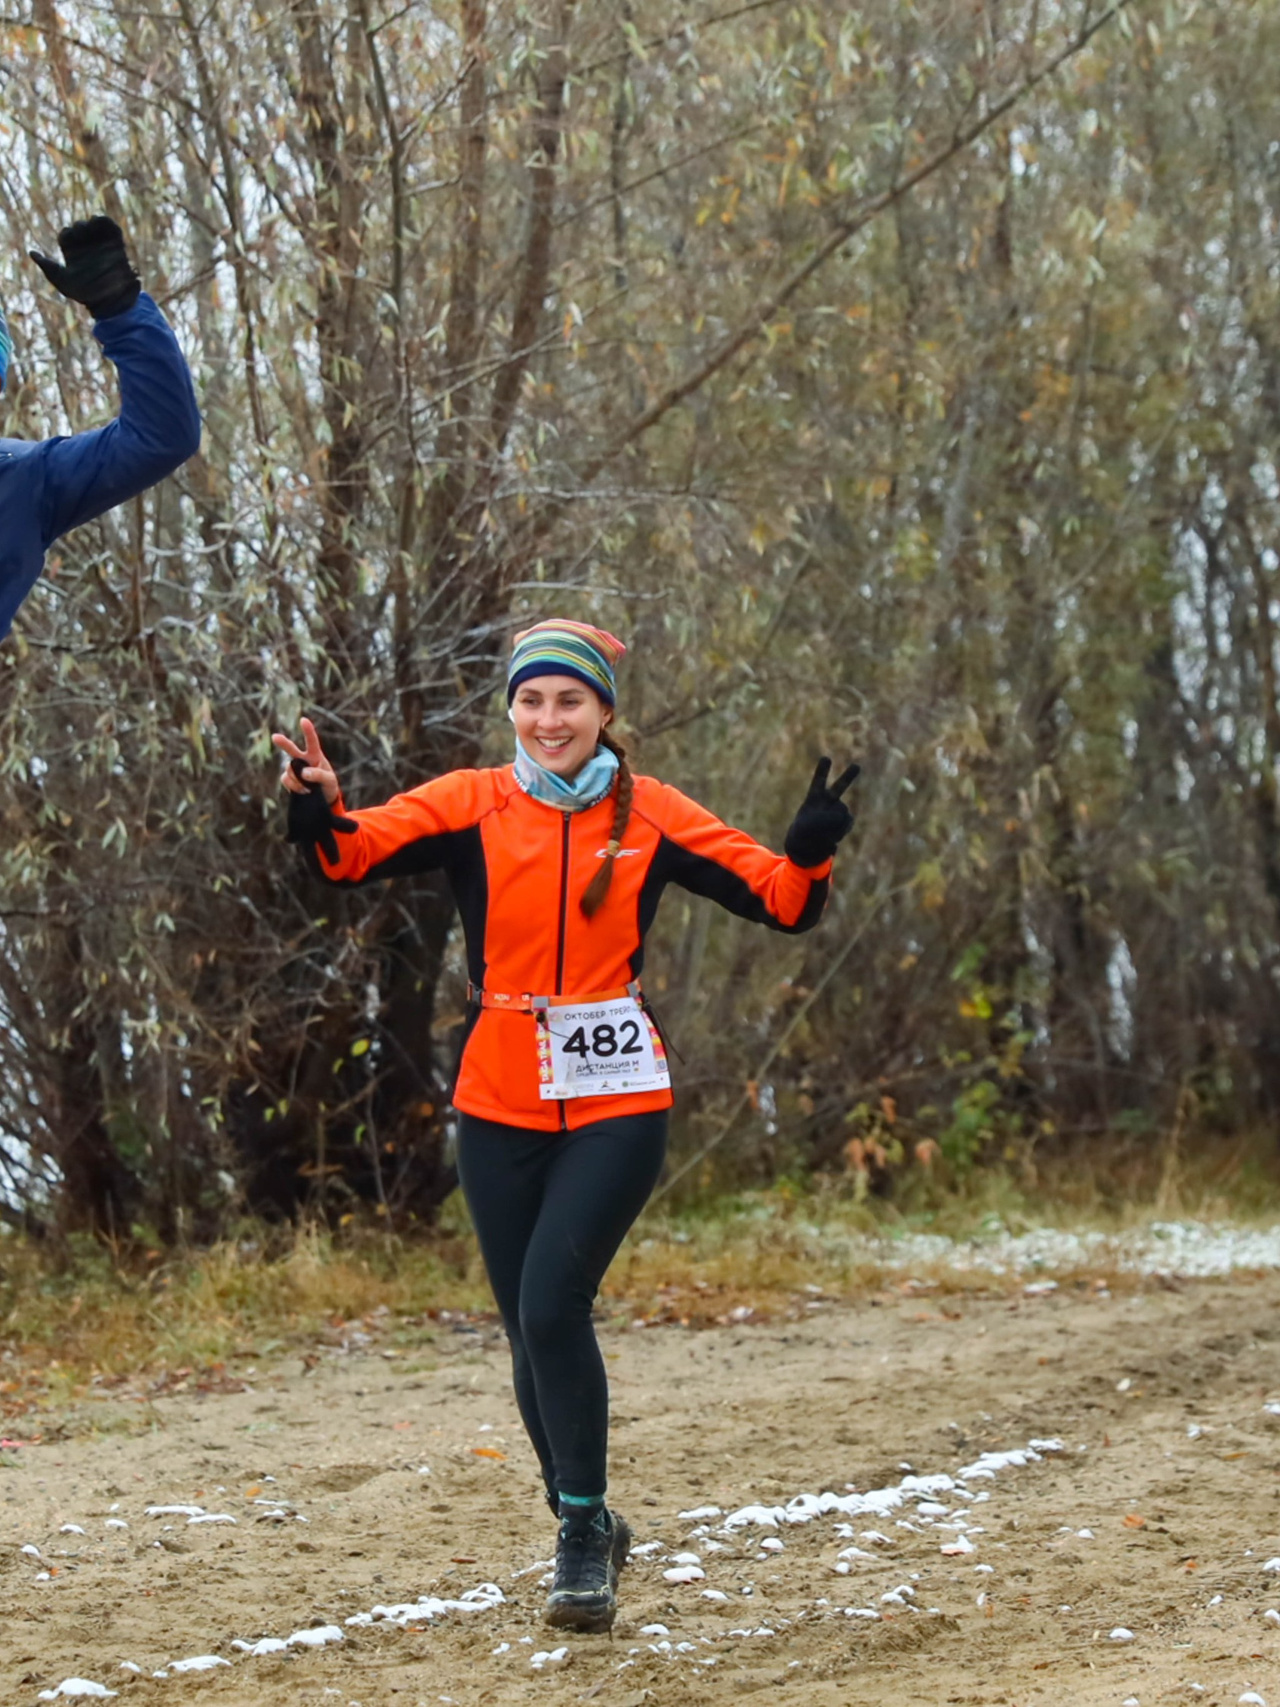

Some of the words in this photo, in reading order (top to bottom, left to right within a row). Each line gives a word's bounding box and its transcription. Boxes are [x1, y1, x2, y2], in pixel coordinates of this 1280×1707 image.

[564, 1010, 606, 1021] ОКТОБЕР
[562, 1020, 643, 1058] 482
[575, 1061, 630, 1073] ДИСТАНЦИЯ
